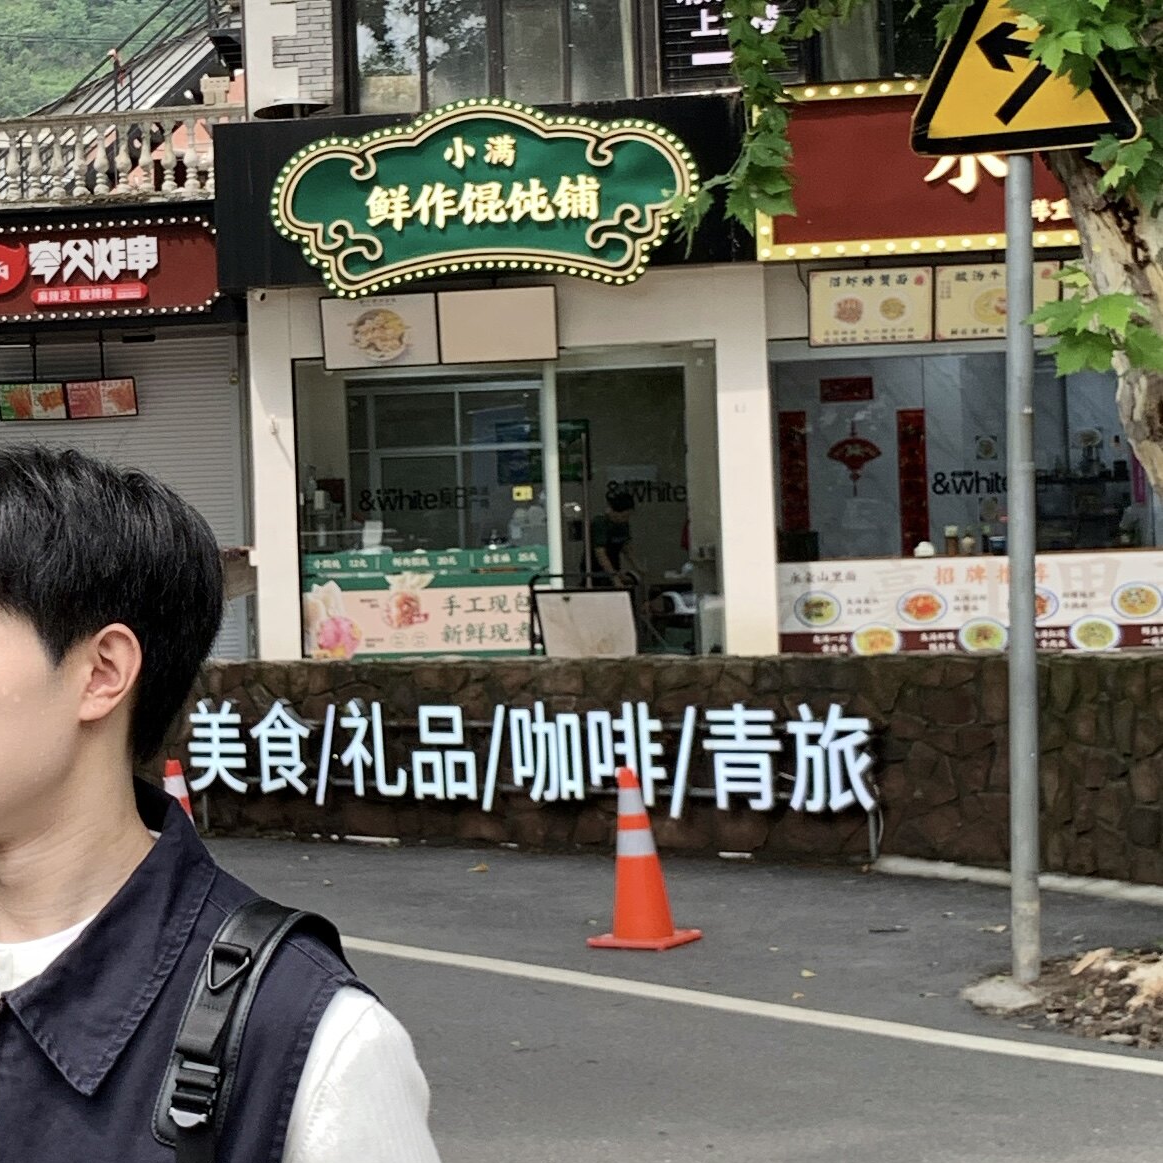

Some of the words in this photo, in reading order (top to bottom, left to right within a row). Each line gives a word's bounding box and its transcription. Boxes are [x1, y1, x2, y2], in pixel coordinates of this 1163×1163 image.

[443, 134, 517, 169] 小满
[365, 174, 601, 231] 鲜作馄饨铺
[28, 235, 159, 284] 夸父炸串
[443, 592, 531, 616] 手工现包
[187, 700, 876, 819] 美食/礼品/咖啡/青旅
